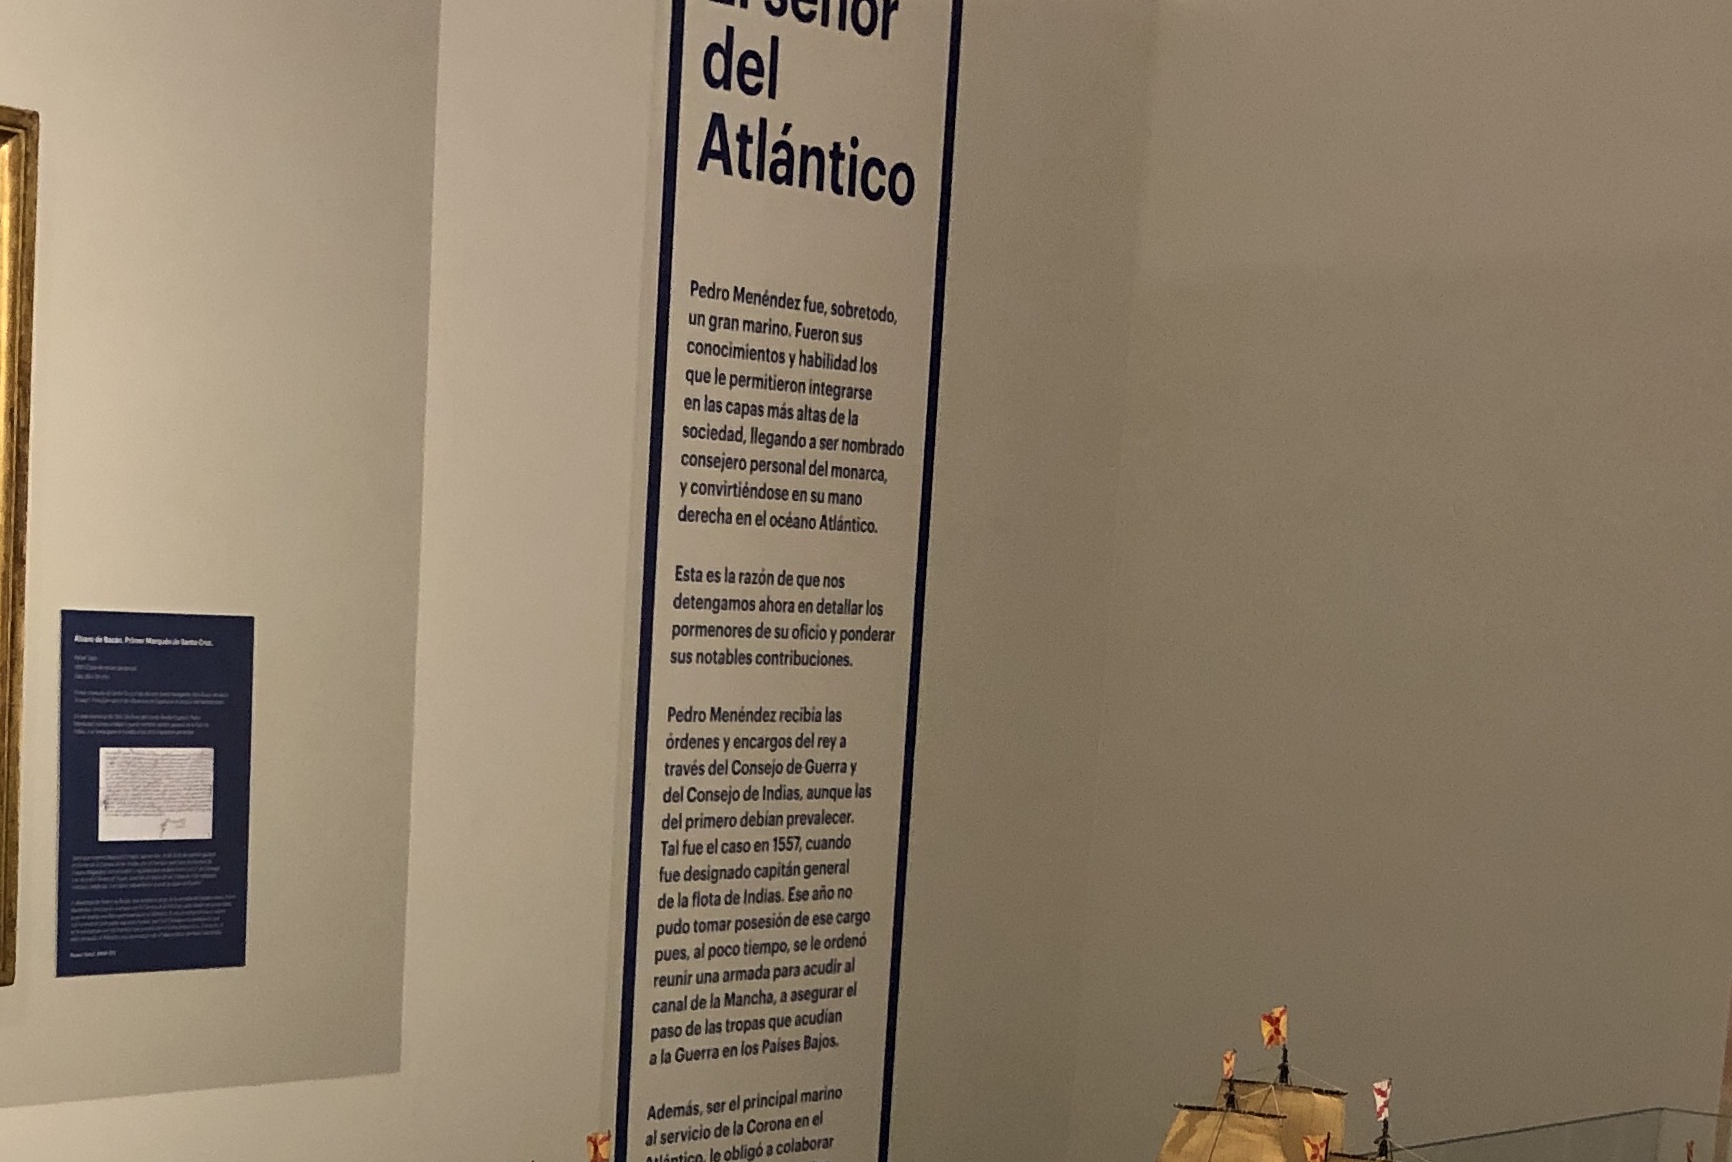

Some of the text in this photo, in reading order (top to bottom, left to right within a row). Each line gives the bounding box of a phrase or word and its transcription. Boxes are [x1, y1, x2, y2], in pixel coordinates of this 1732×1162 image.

[702, 25, 779, 100] del
[697, 111, 915, 206] Atlántico
[690, 279, 730, 302] Pedro
[732, 285, 802, 311] Menéndez
[830, 300, 898, 326] sobretodo,
[688, 312, 706, 327] un
[708, 314, 740, 333] gran
[794, 321, 840, 344] Fueron
[841, 331, 863, 347] sus
[686, 340, 878, 375] conocimientos y habilidad los
[685, 367, 873, 402] que le permitieron integrarse
[683, 393, 859, 427] en las capas más altas de la
[749, 426, 807, 450] llegando
[808, 436, 817, 450] a
[819, 437, 840, 451] ser
[841, 437, 905, 457] nombrado
[680, 452, 747, 473] consejero
[749, 458, 807, 476] personal
[808, 459, 829, 477] del
[679, 479, 863, 507] y convirtiéndose en su mano
[677, 504, 733, 525] derecha
[735, 512, 752, 526] en
[754, 509, 767, 527] el
[769, 511, 817, 531] océano
[674, 564, 846, 591] Esta es la razón de que nos
[672, 592, 884, 617] detengamos ahora en detallar los
[671, 621, 896, 645] pormenores de su oficio y ponderar
[669, 651, 693, 665] sus
[695, 647, 753, 666] notables
[667, 705, 707, 723] Pedro
[709, 705, 777, 723] Menéndez
[824, 706, 843, 723] las
[722, 736, 731, 753] y
[732, 736, 793, 753] encargos
[794, 731, 815, 749] del
[816, 736, 838, 752] rey
[839, 736, 847, 749] a
[664, 758, 858, 779] través del Consejo de Guerra y
[706, 1101, 727, 1115] ser
[728, 1094, 741, 1112] el
[742, 1088, 798, 1114] principal
[800, 1085, 843, 1103] marino
[644, 1109, 824, 1147] al servicio de la Corona en el
